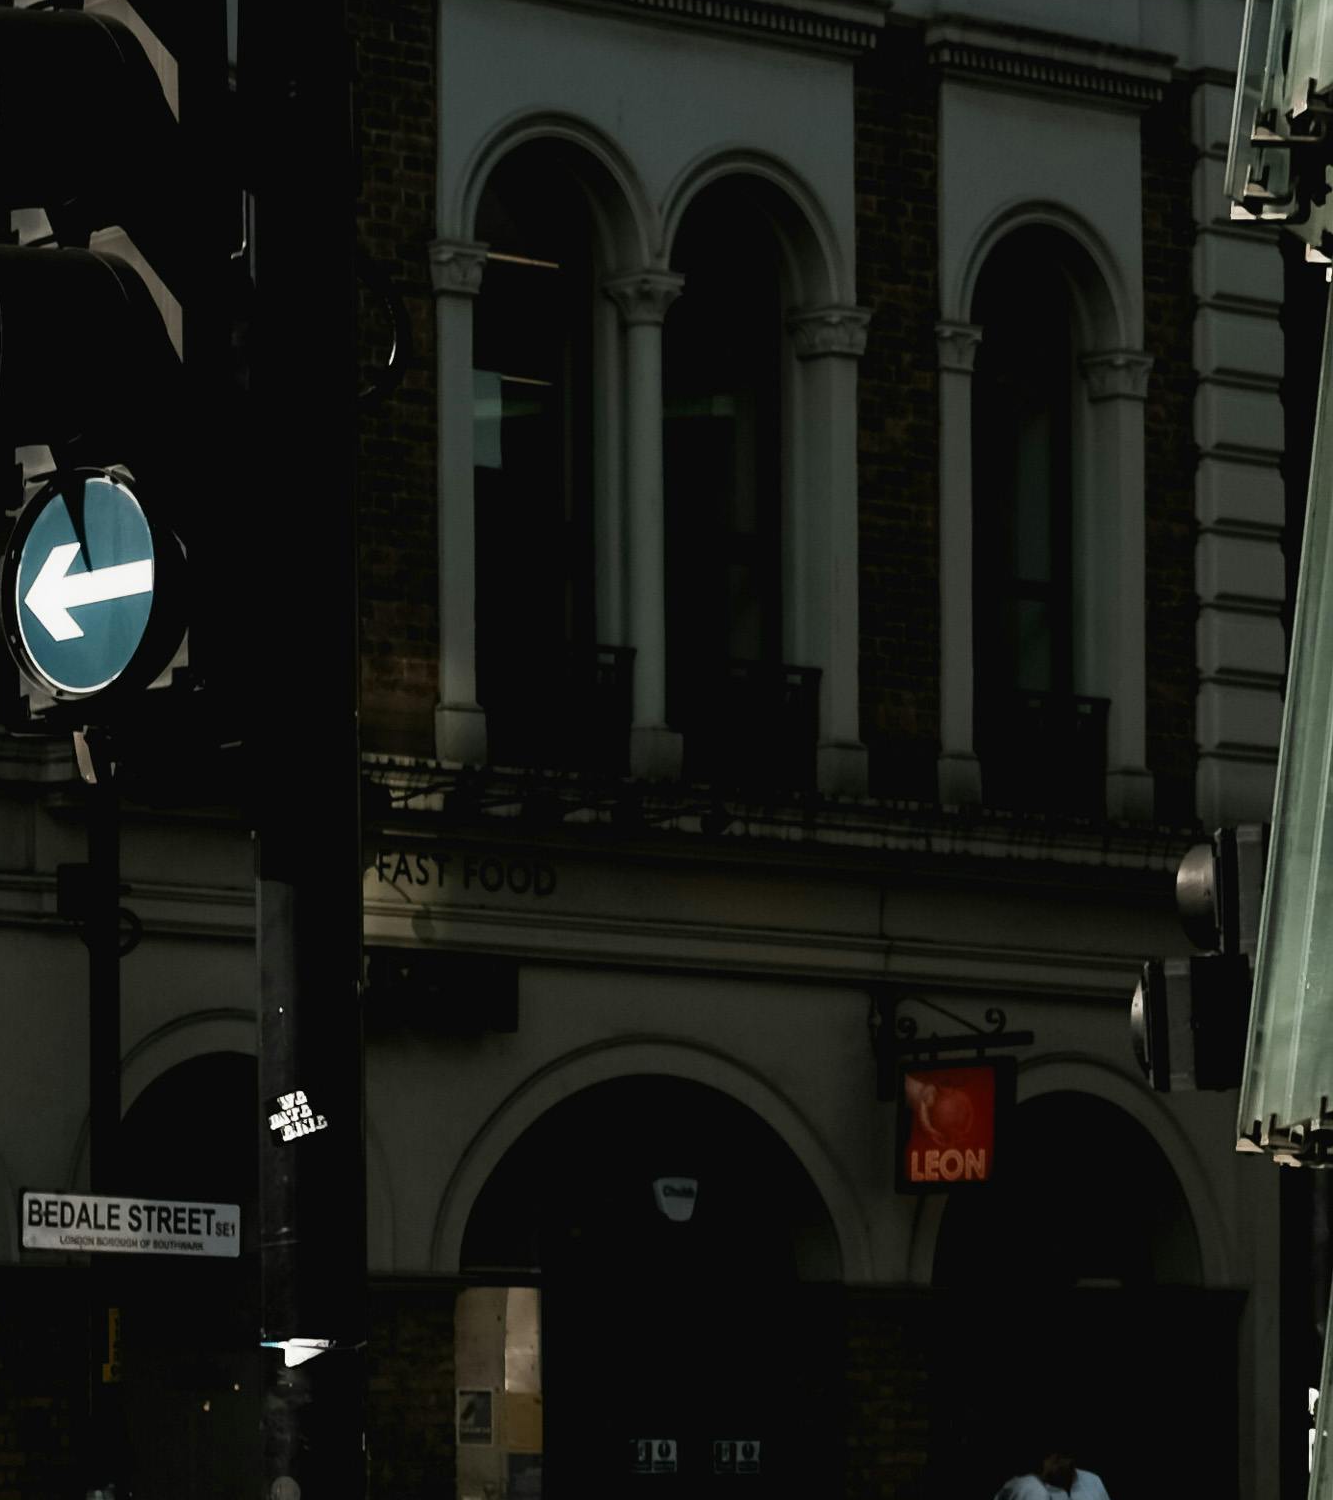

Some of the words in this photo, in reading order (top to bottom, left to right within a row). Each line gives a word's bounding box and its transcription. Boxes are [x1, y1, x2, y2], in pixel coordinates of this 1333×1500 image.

[378, 851, 452, 887] FAST
[464, 856, 556, 895] FOOD
[910, 1148, 986, 1182] LEON
[27, 1198, 121, 1231] BEDALE
[127, 1204, 216, 1236] STREET
[216, 1220, 236, 1237] SE1
[59, 1235, 95, 1246] LONDON
[96, 1237, 138, 1248] BOROUGH
[140, 1238, 151, 1248] OF
[153, 1239, 204, 1251] SOUTHWARK
